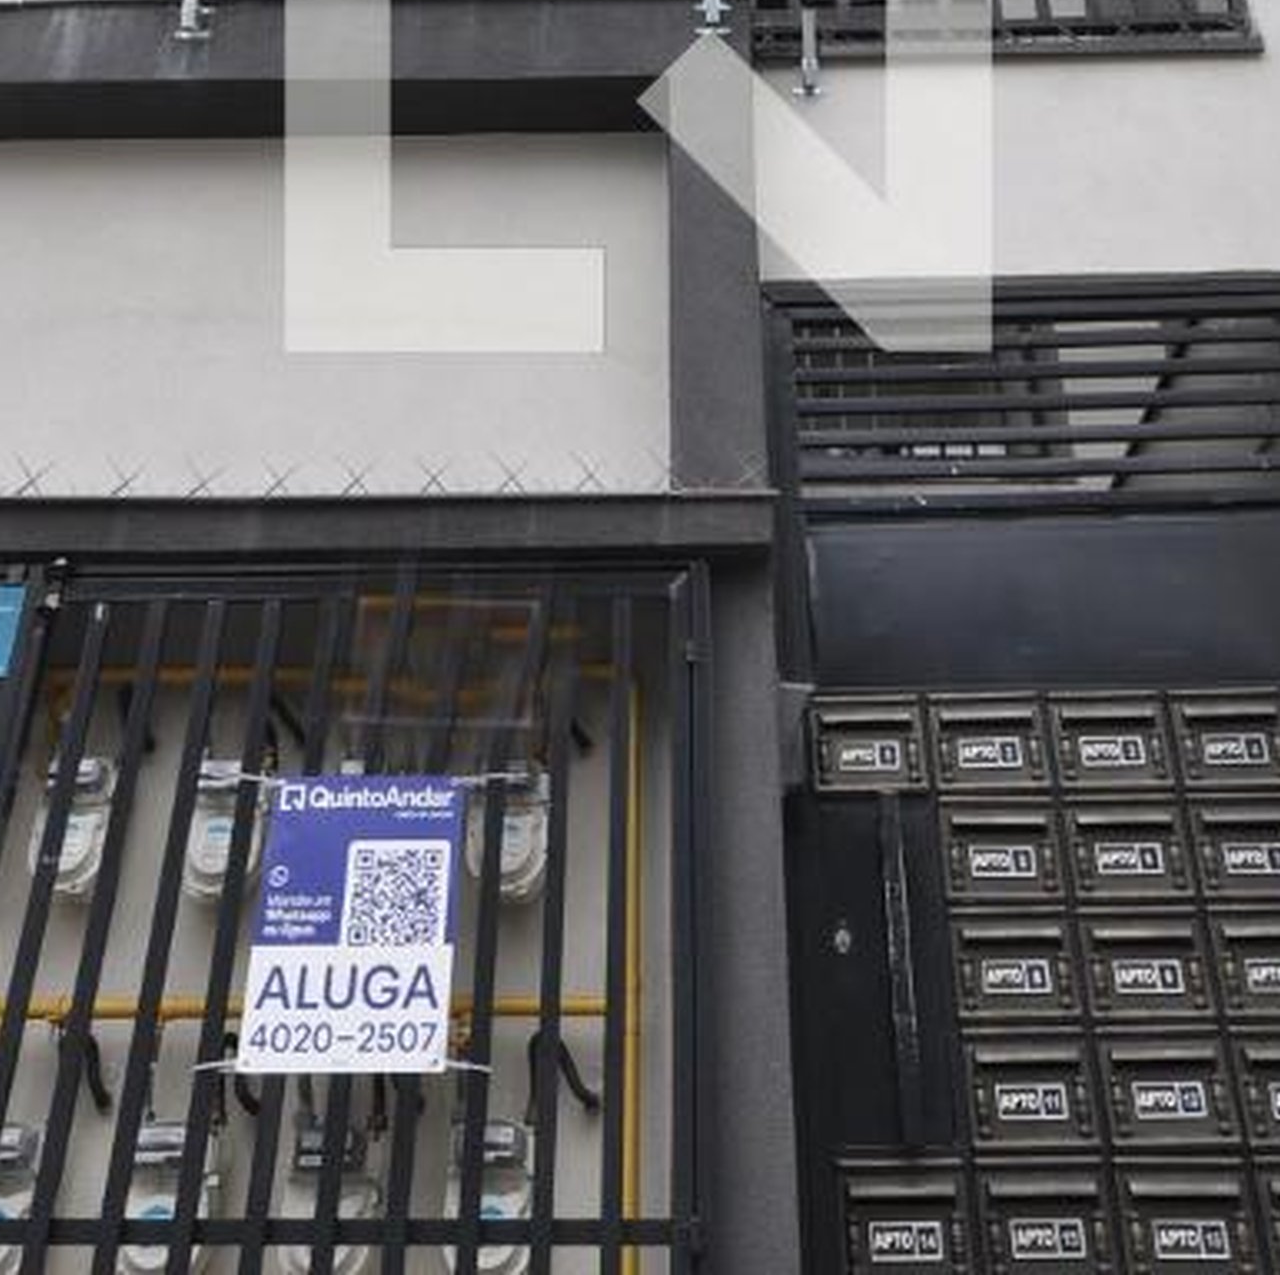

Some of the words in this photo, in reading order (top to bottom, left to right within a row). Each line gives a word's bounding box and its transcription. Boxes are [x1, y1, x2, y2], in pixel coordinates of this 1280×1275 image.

[842, 749, 874, 761] APTO
[963, 745, 996, 759] APTO
[1082, 743, 1119, 756] APTO
[1206, 742, 1243, 755] APTO
[309, 785, 455, 809] QuintoAndar
[973, 853, 1010, 867] APTO
[1100, 850, 1136, 864] APTO
[1229, 850, 1265, 865] APTO
[987, 968, 1022, 983] APTO
[1119, 968, 1155, 983] APTO
[254, 963, 439, 1010] ALUGA
[249, 1022, 438, 1053] 4020-2507
[1001, 1093, 1039, 1110] APTO
[1045, 1093, 1060, 1109] 11
[1140, 1091, 1176, 1108] APTO
[874, 1231, 914, 1249] APTO
[921, 1233, 936, 1249] 14
[1017, 1228, 1053, 1247] APTO
[1160, 1229, 1199, 1246] APTO
